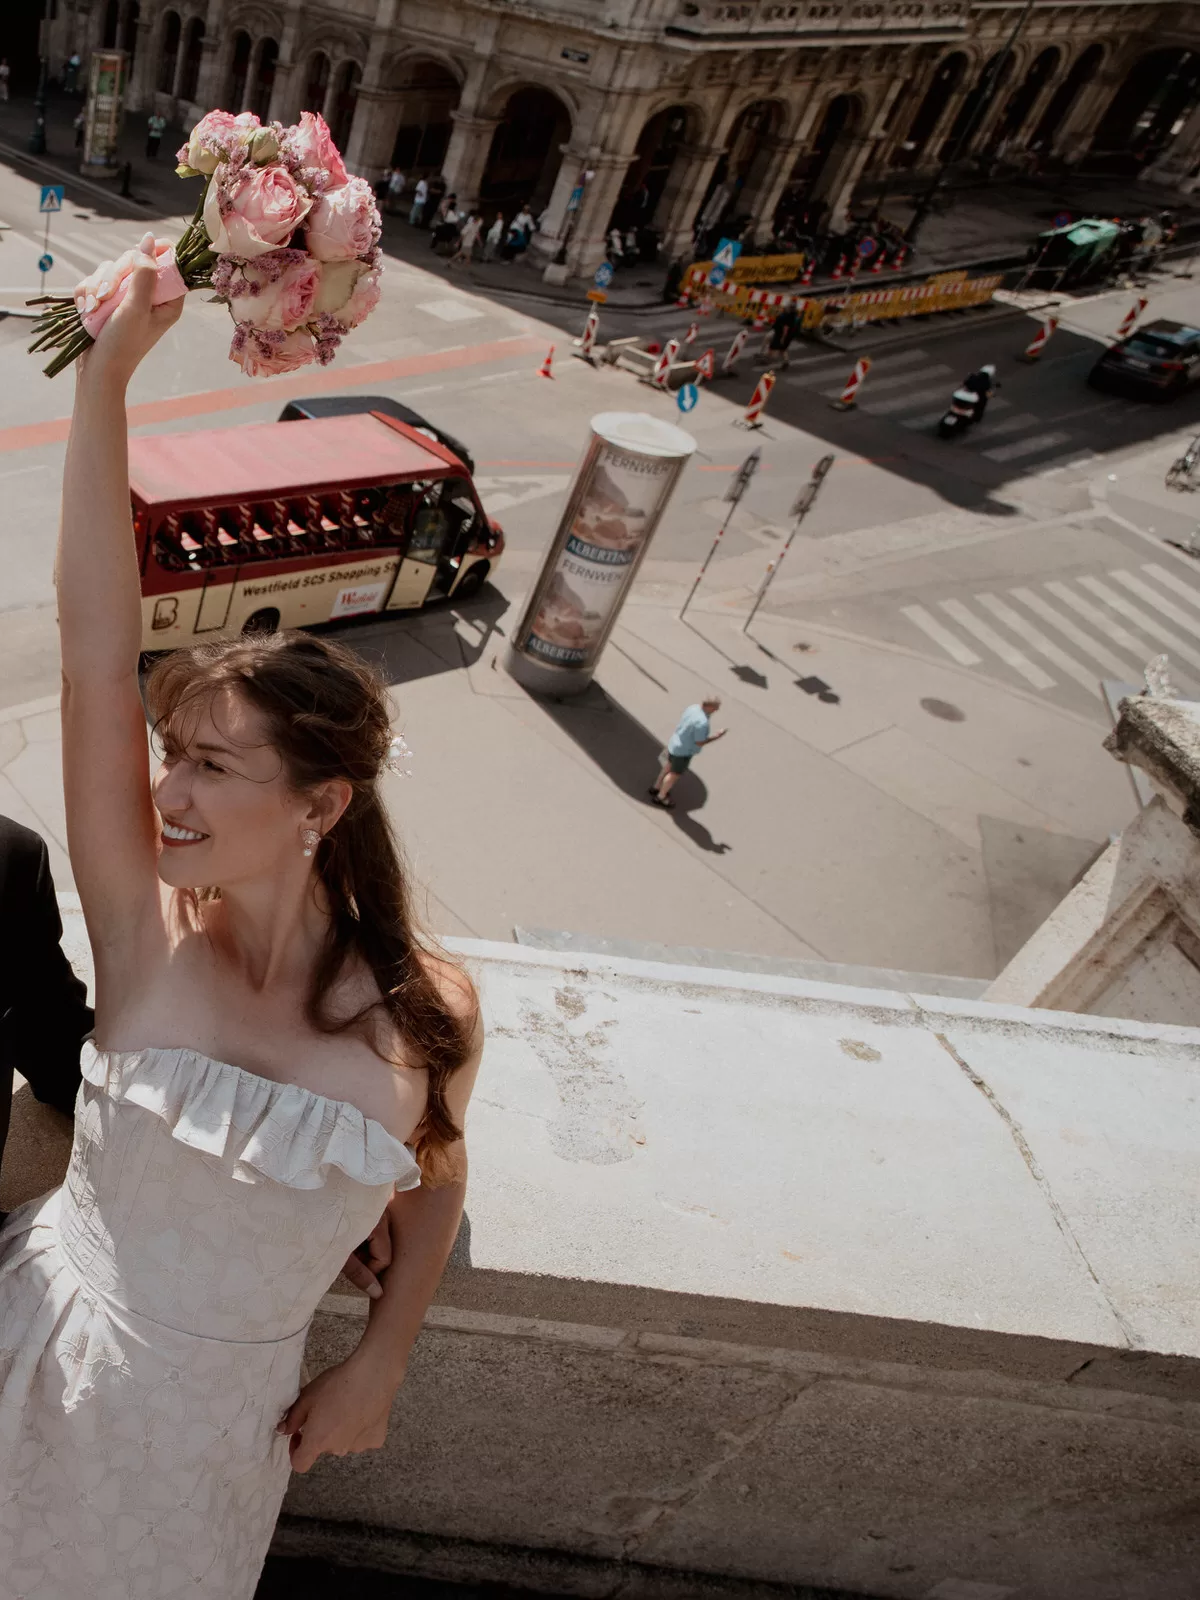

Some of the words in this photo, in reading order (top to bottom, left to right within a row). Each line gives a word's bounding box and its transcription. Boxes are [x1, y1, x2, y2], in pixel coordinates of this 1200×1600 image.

[567, 539, 633, 563] ALBERTIN
[243, 577, 301, 597] Westfield
[302, 573, 326, 588] SCS
[328, 564, 381, 582] Shopping
[528, 637, 586, 660] ALBERTIN
